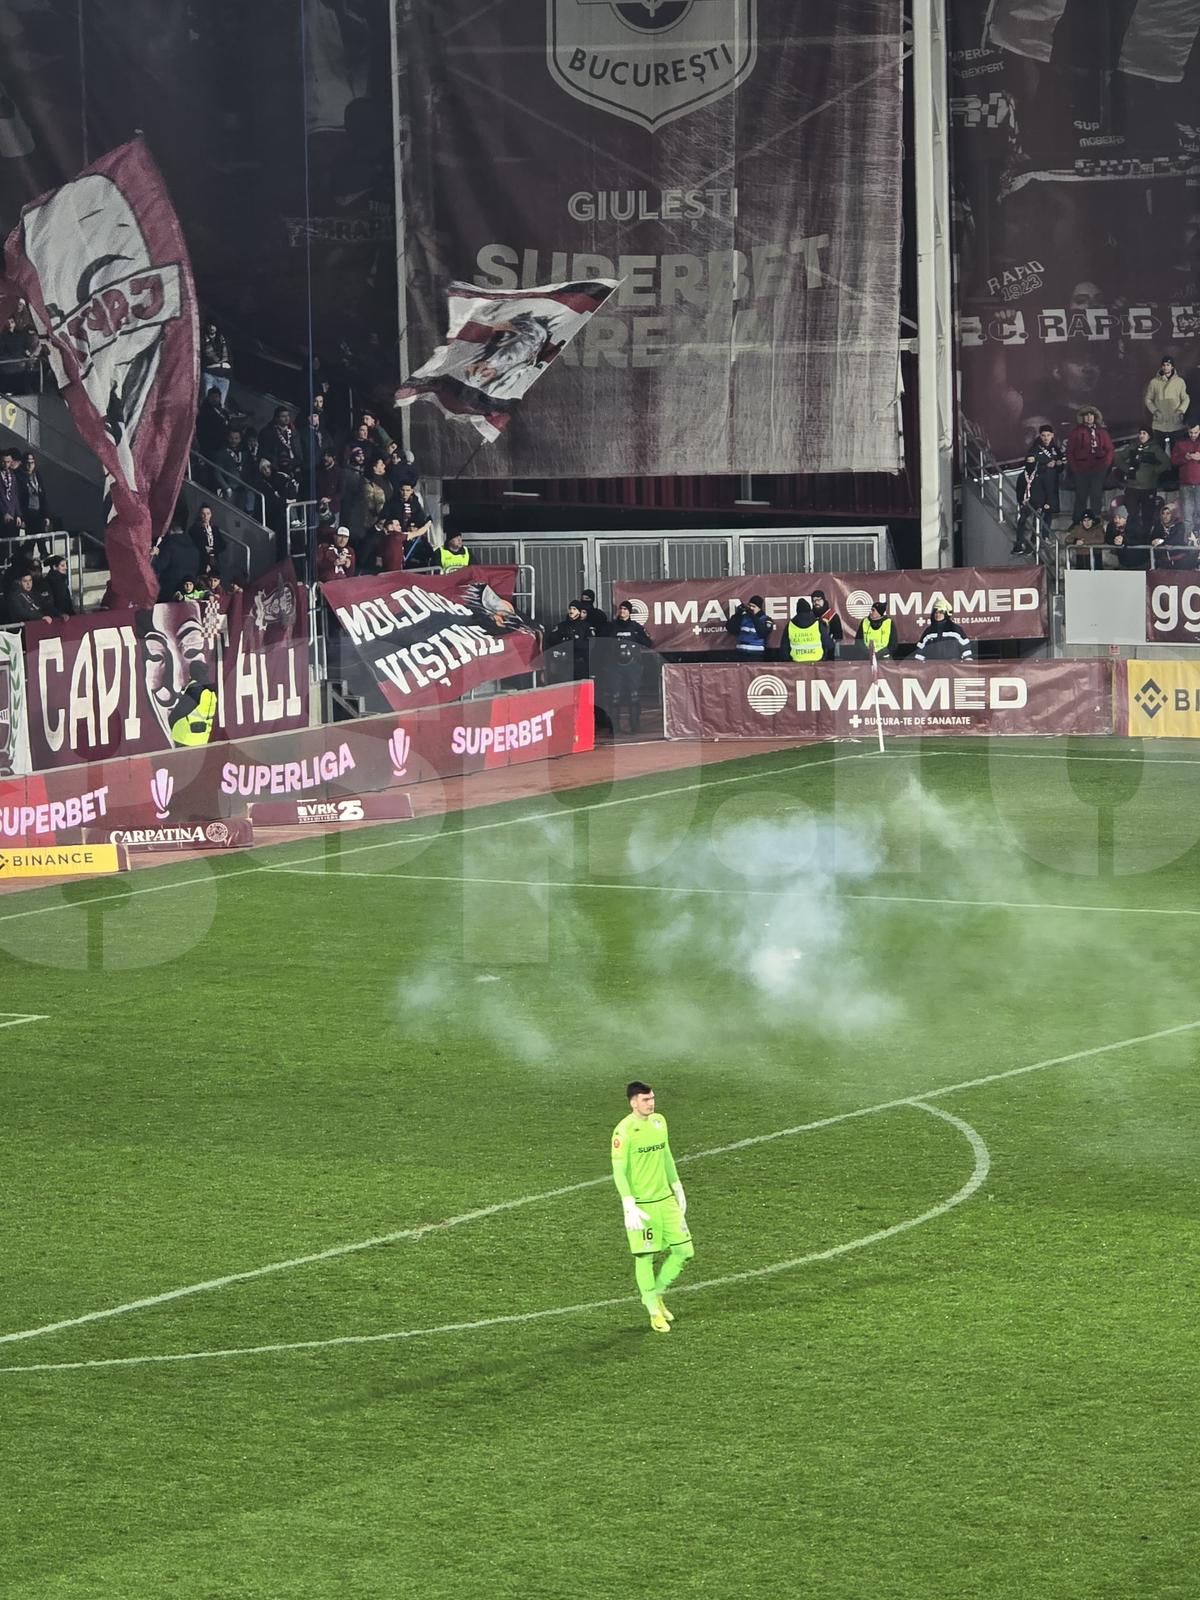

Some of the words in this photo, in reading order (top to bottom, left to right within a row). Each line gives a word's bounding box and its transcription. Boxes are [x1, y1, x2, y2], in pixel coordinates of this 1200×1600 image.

[569, 44, 733, 87] BUCUREȘTI
[567, 188, 738, 229] GIULEȘTI
[473, 234, 830, 307] SUPERBET
[986, 260, 1045, 295] RAPID
[1001, 274, 1043, 303] 1923
[1037, 311, 1163, 340] RAPID
[795, 677, 1029, 712] IMAMED
[451, 710, 555, 756] SUPERBET
[914, 716, 926, 726] DE
[927, 716, 971, 726] SANATATE
[220, 743, 357, 796] SUPERLIGA
[0, 785, 109, 837] UPERBET
[307, 803, 338, 816] VRK
[109, 826, 207, 845] CARPATINA
[12, 852, 94, 867] BINANCE
[642, 1227, 654, 1241] 16
